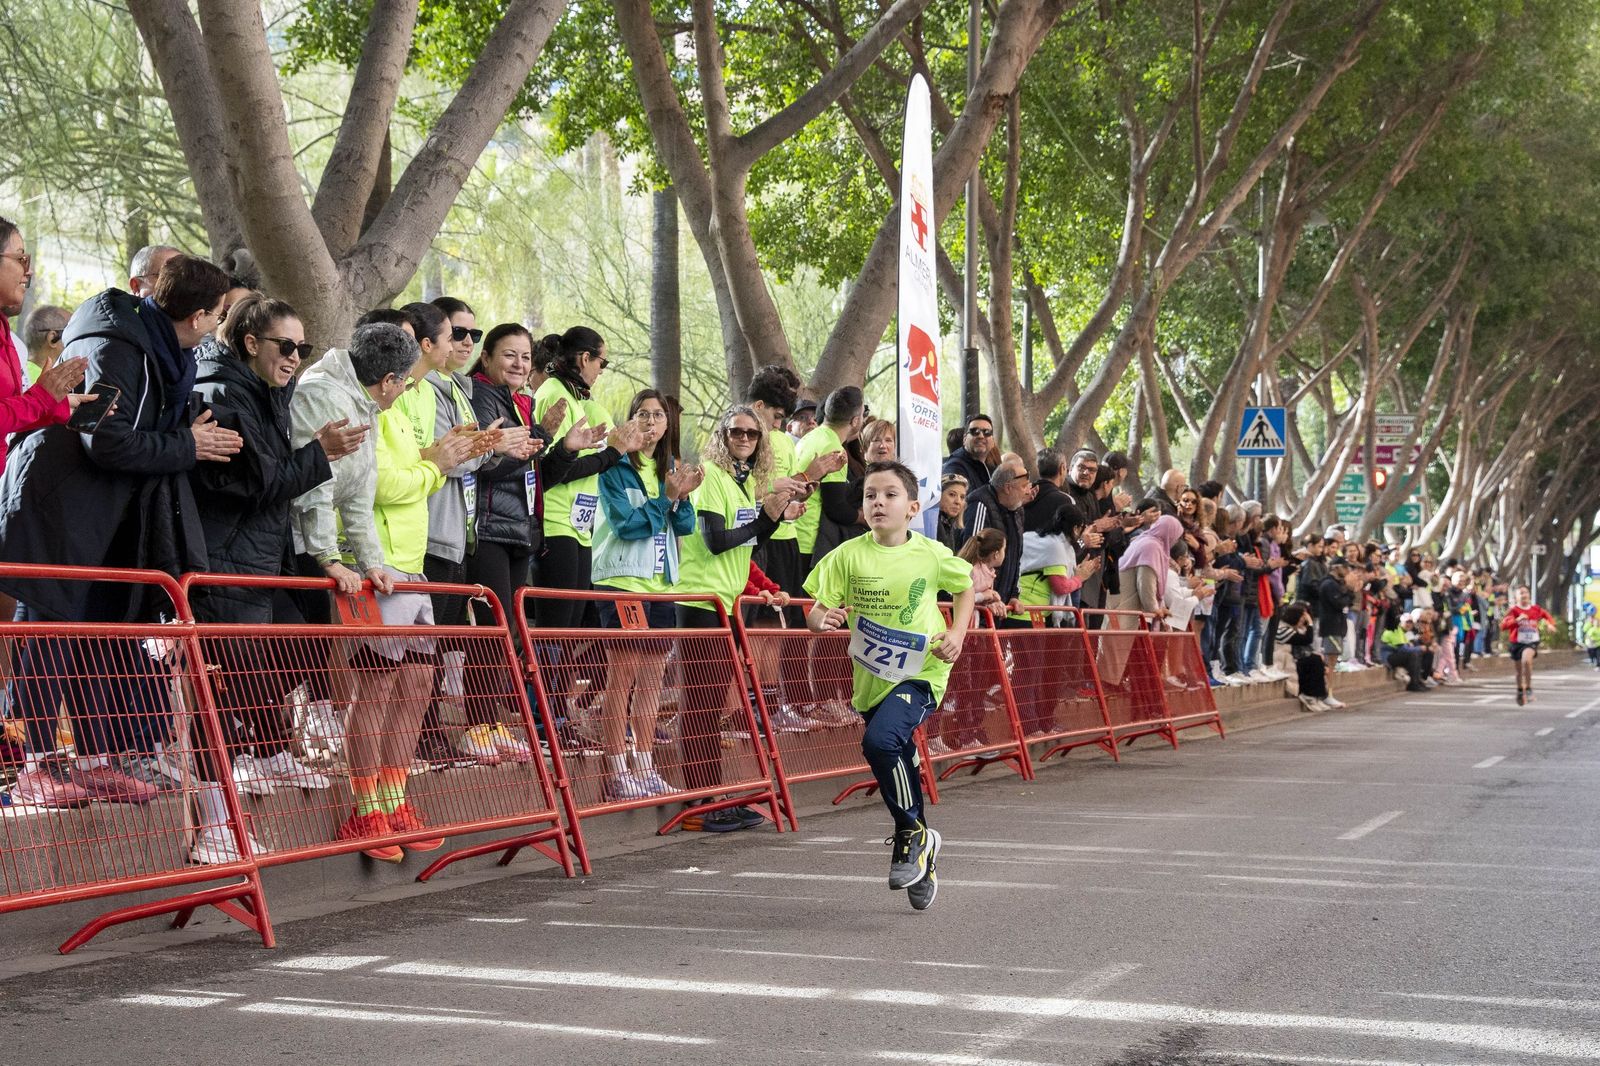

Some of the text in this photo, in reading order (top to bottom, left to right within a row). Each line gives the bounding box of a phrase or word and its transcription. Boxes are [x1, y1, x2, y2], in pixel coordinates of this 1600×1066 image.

[858, 587, 890, 597] Almería
[865, 622, 888, 635] Almería
[862, 627, 881, 639] contra
[888, 638, 909, 647] cáncer
[863, 638, 908, 670] 721
